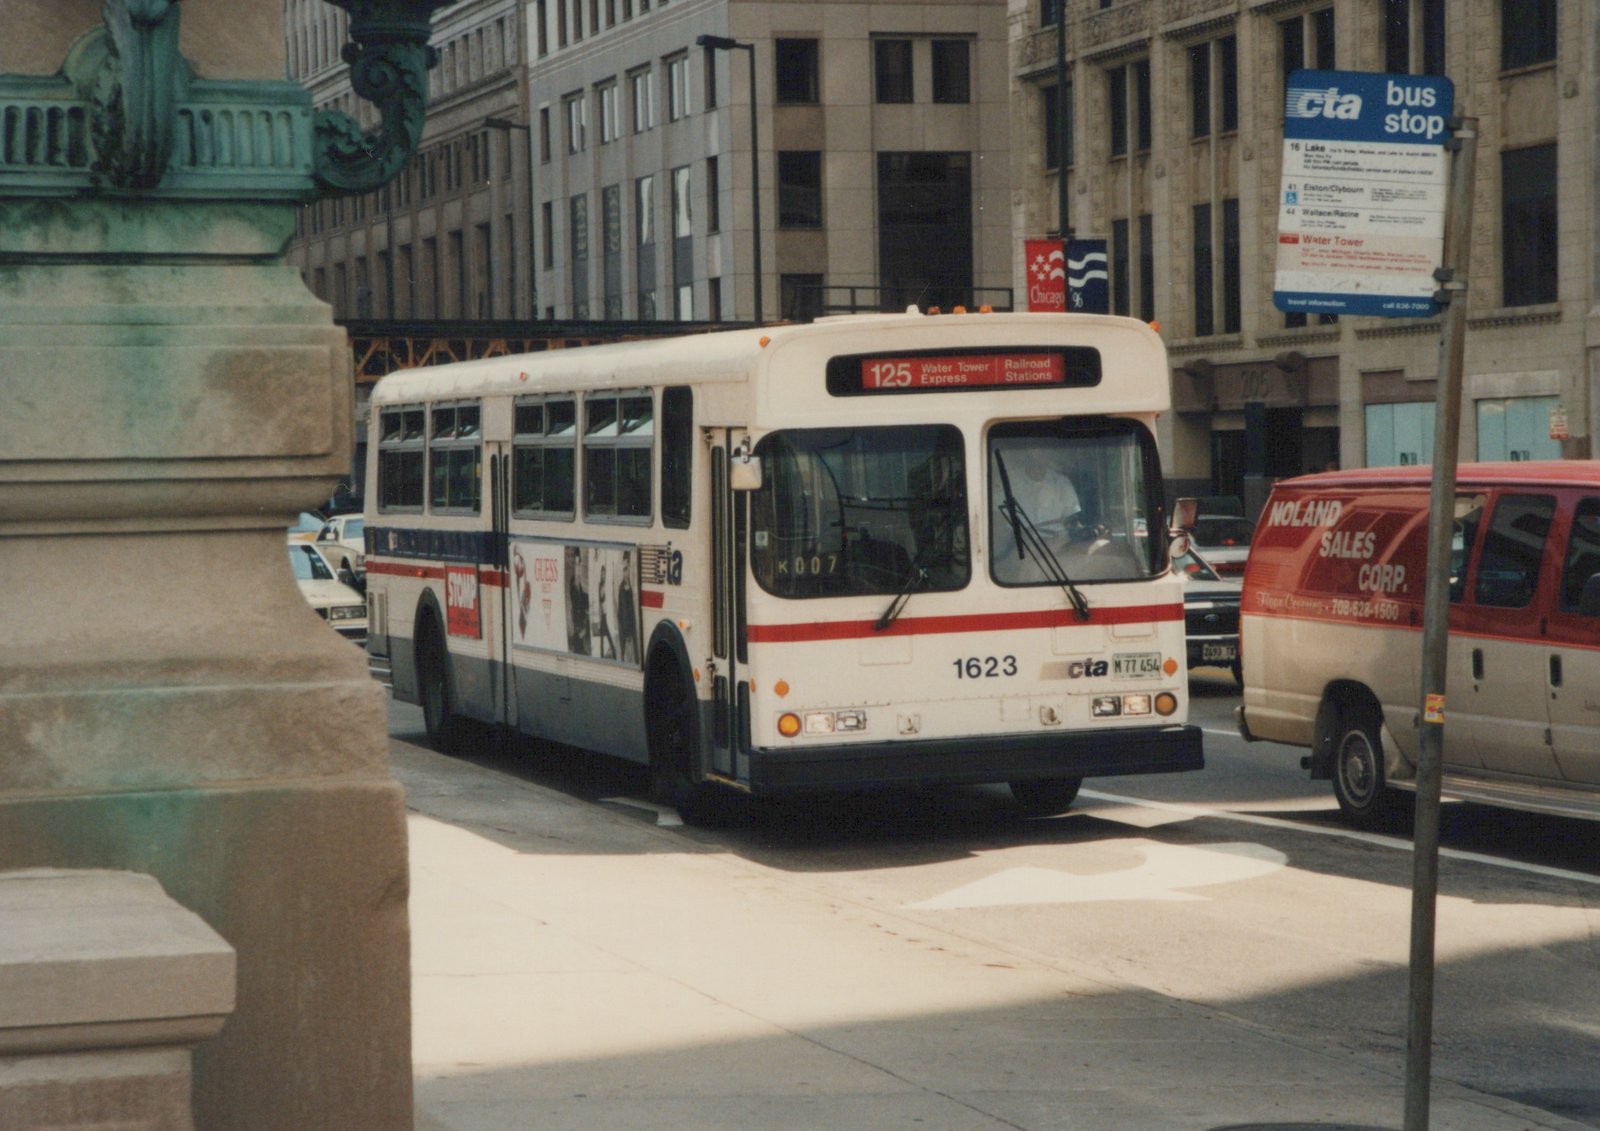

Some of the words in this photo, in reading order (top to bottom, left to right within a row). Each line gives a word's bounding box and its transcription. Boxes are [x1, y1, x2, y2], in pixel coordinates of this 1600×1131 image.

[1292, 87, 1362, 120] cta
[1387, 80, 1436, 108] bus
[1384, 109, 1444, 140] stop
[1290, 143, 1300, 151] 16
[1305, 143, 1326, 152] Lake
[1302, 209, 1359, 218] Wallace/Racine
[1302, 234, 1332, 244] Water
[1334, 236, 1364, 247] Tower
[1031, 285, 1065, 309] Chicago
[871, 363, 912, 388] 125
[921, 363, 952, 374] Water
[958, 361, 989, 373] Tower
[1004, 358, 1051, 370] Railroad
[921, 373, 967, 386] Express
[1004, 371, 1052, 382] Stations
[1268, 500, 1343, 528] NOLAND
[1319, 531, 1376, 559] SALES
[534, 557, 559, 583] GUESS
[1358, 563, 1408, 593] CORP.
[953, 655, 1018, 680] 1623
[1066, 657, 1109, 680] cta
[1114, 659, 1122, 673] M
[1124, 659, 1136, 673] 77
[1140, 658, 1160, 672] 454
